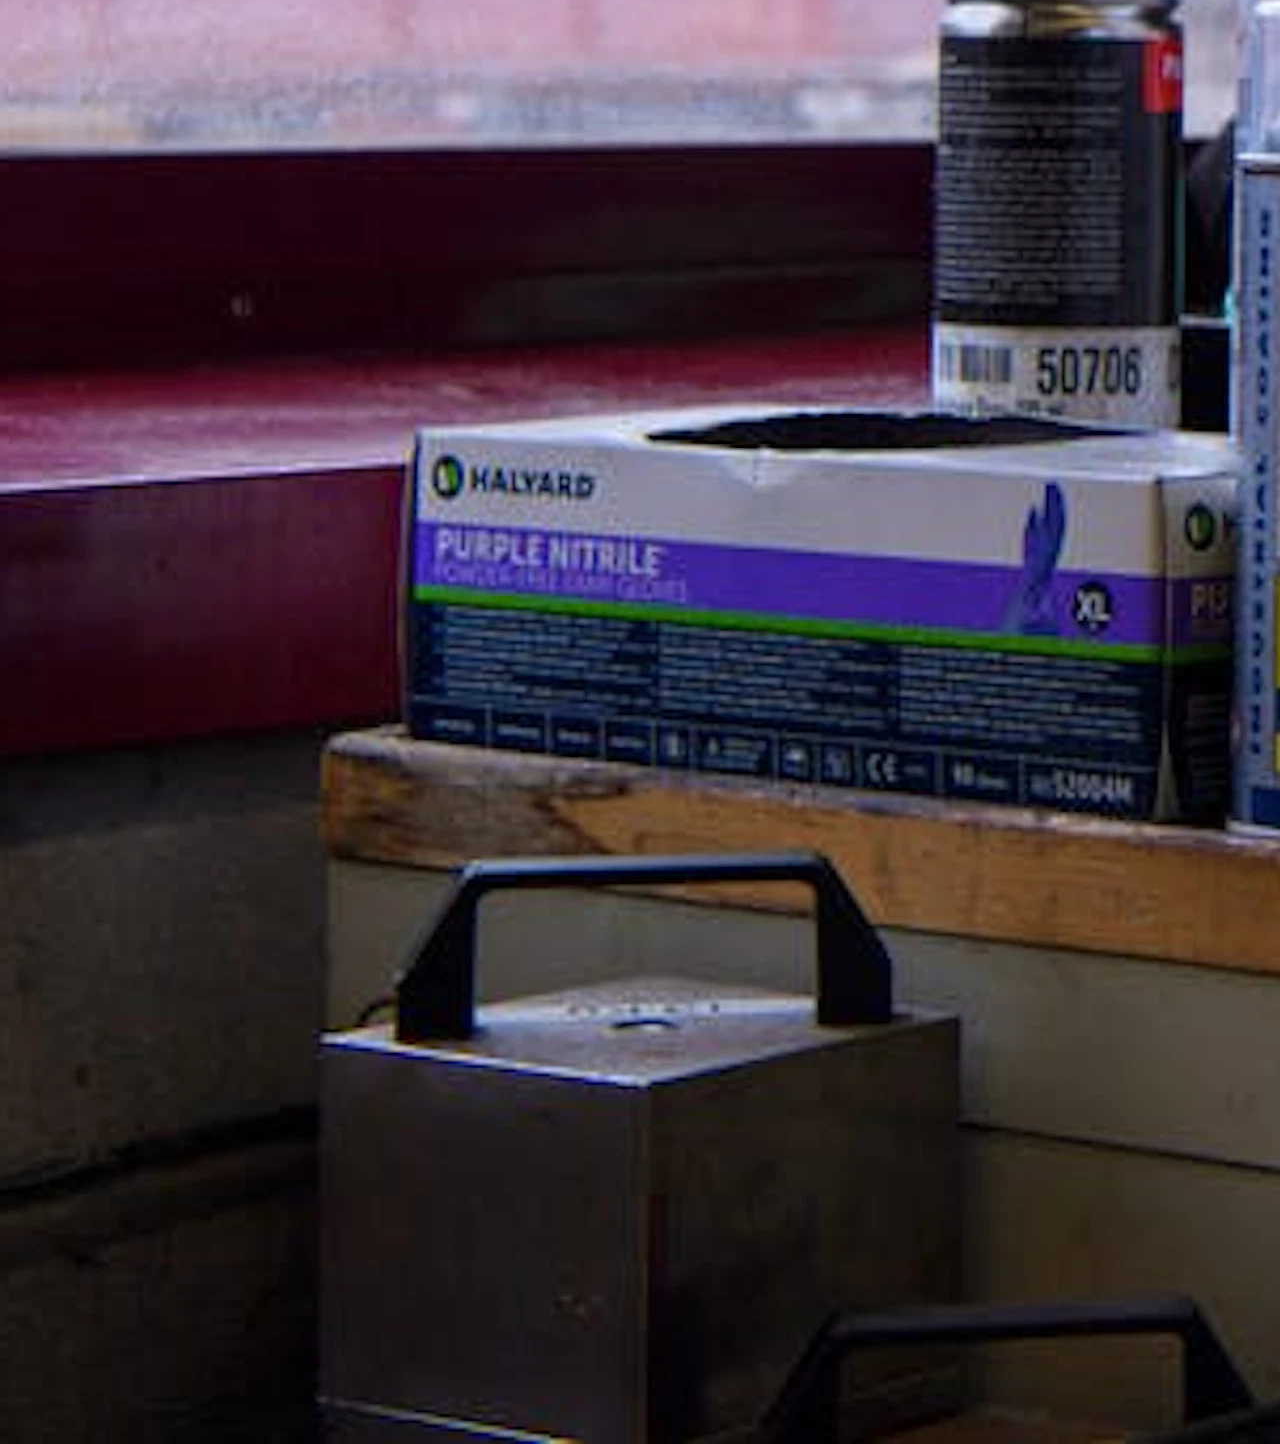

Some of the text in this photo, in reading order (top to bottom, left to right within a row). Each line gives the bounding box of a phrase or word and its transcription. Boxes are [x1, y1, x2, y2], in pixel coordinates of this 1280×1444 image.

[1036, 346, 1142, 396] 50706
[470, 465, 597, 499] HALYARD
[434, 526, 667, 577] PURPLE NITRILE
[1076, 590, 1111, 623] XL
